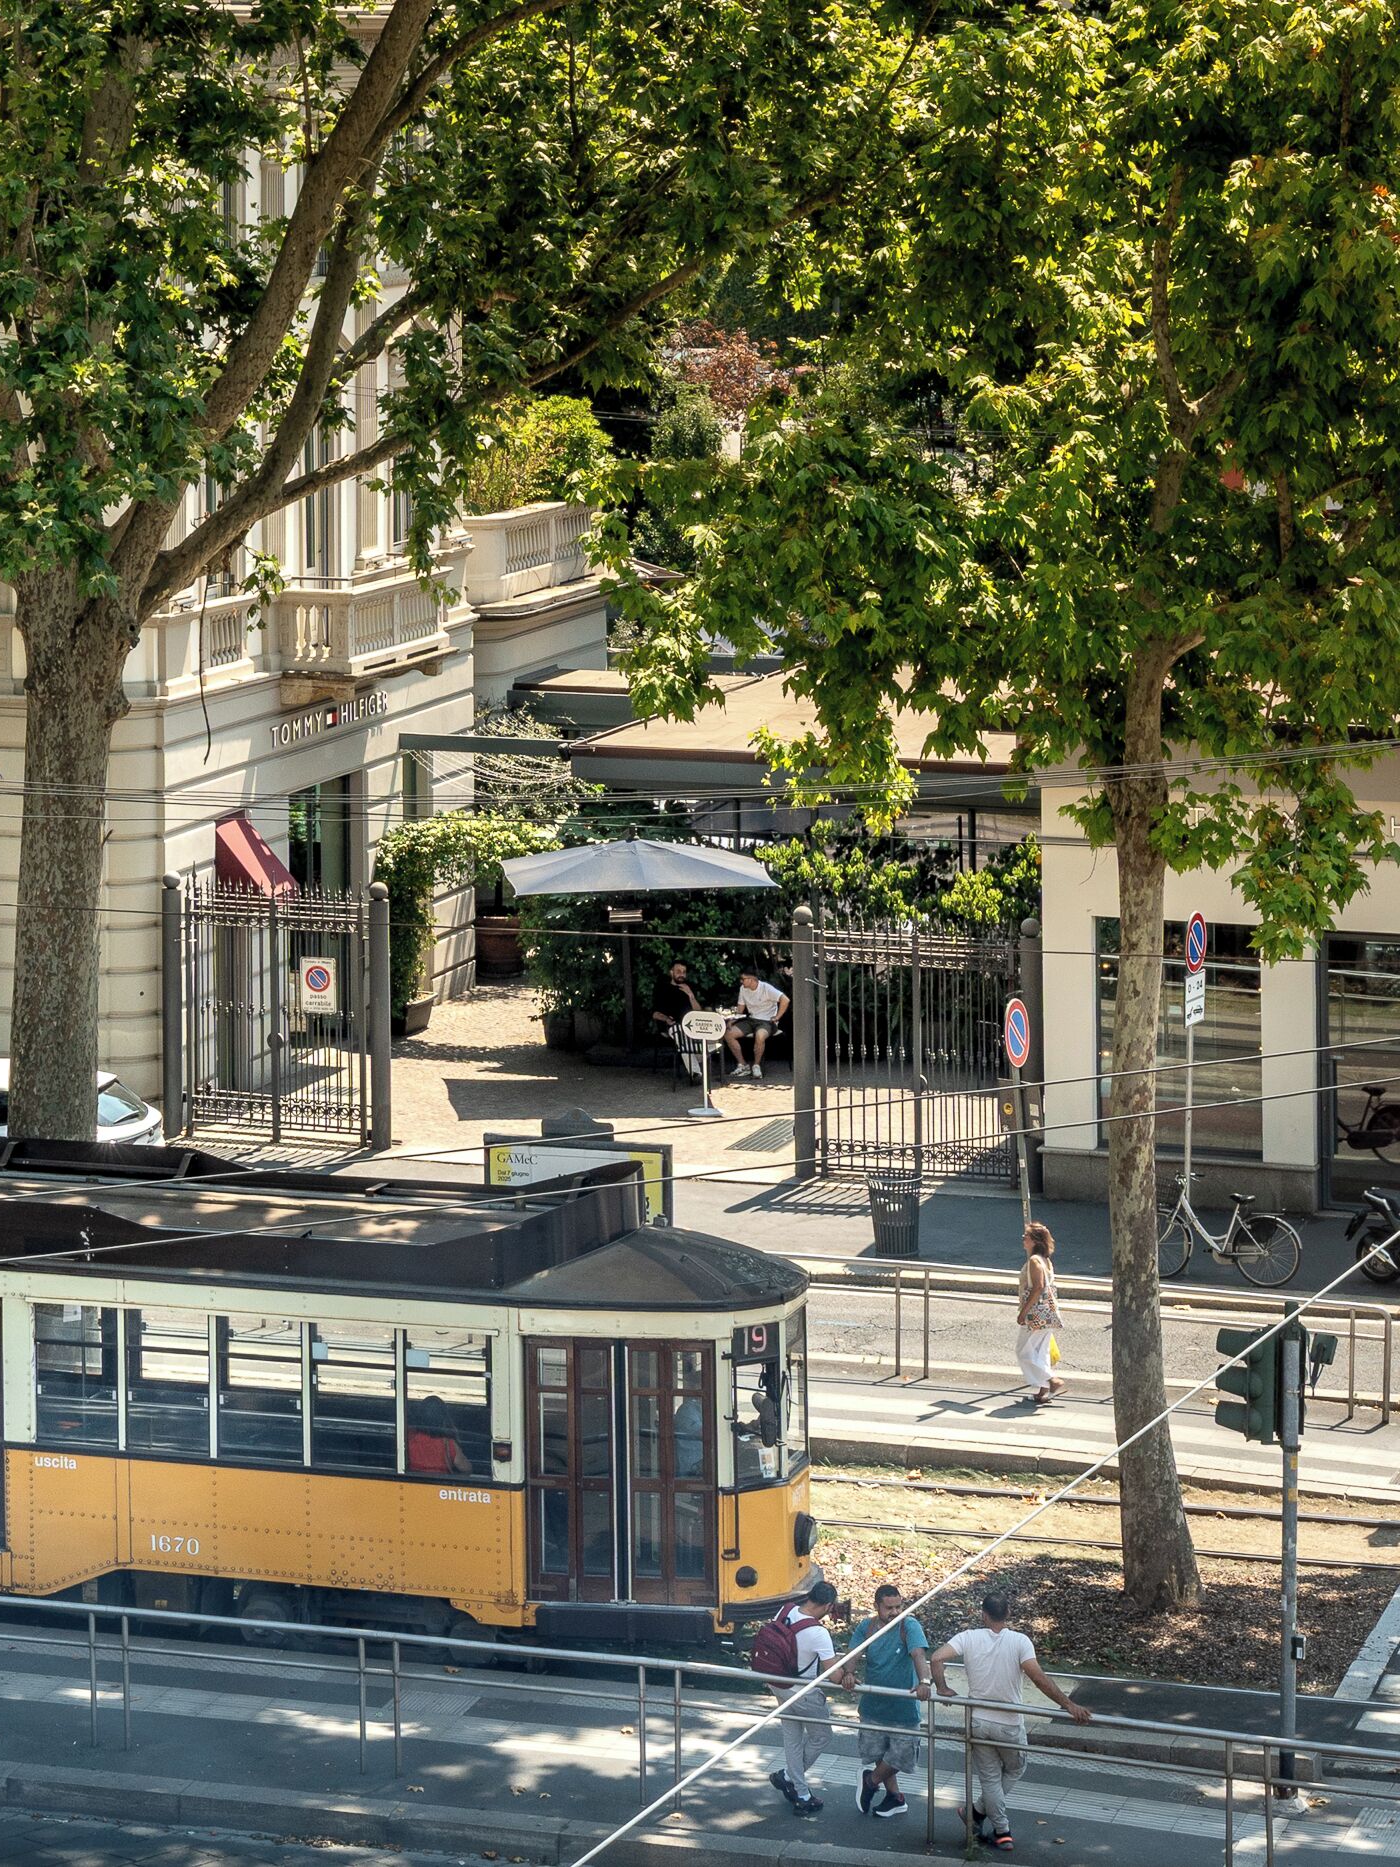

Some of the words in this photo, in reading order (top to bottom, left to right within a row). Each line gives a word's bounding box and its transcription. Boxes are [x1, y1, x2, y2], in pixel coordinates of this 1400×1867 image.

[271, 711, 322, 748] TOMMY
[340, 690, 388, 725] HILFIGER
[497, 1153, 538, 1165] GAMeC
[742, 1325, 768, 1355] 19
[34, 1455, 77, 1470] uscita
[439, 1488, 491, 1504] entrata
[150, 1533, 200, 1556] 1670
